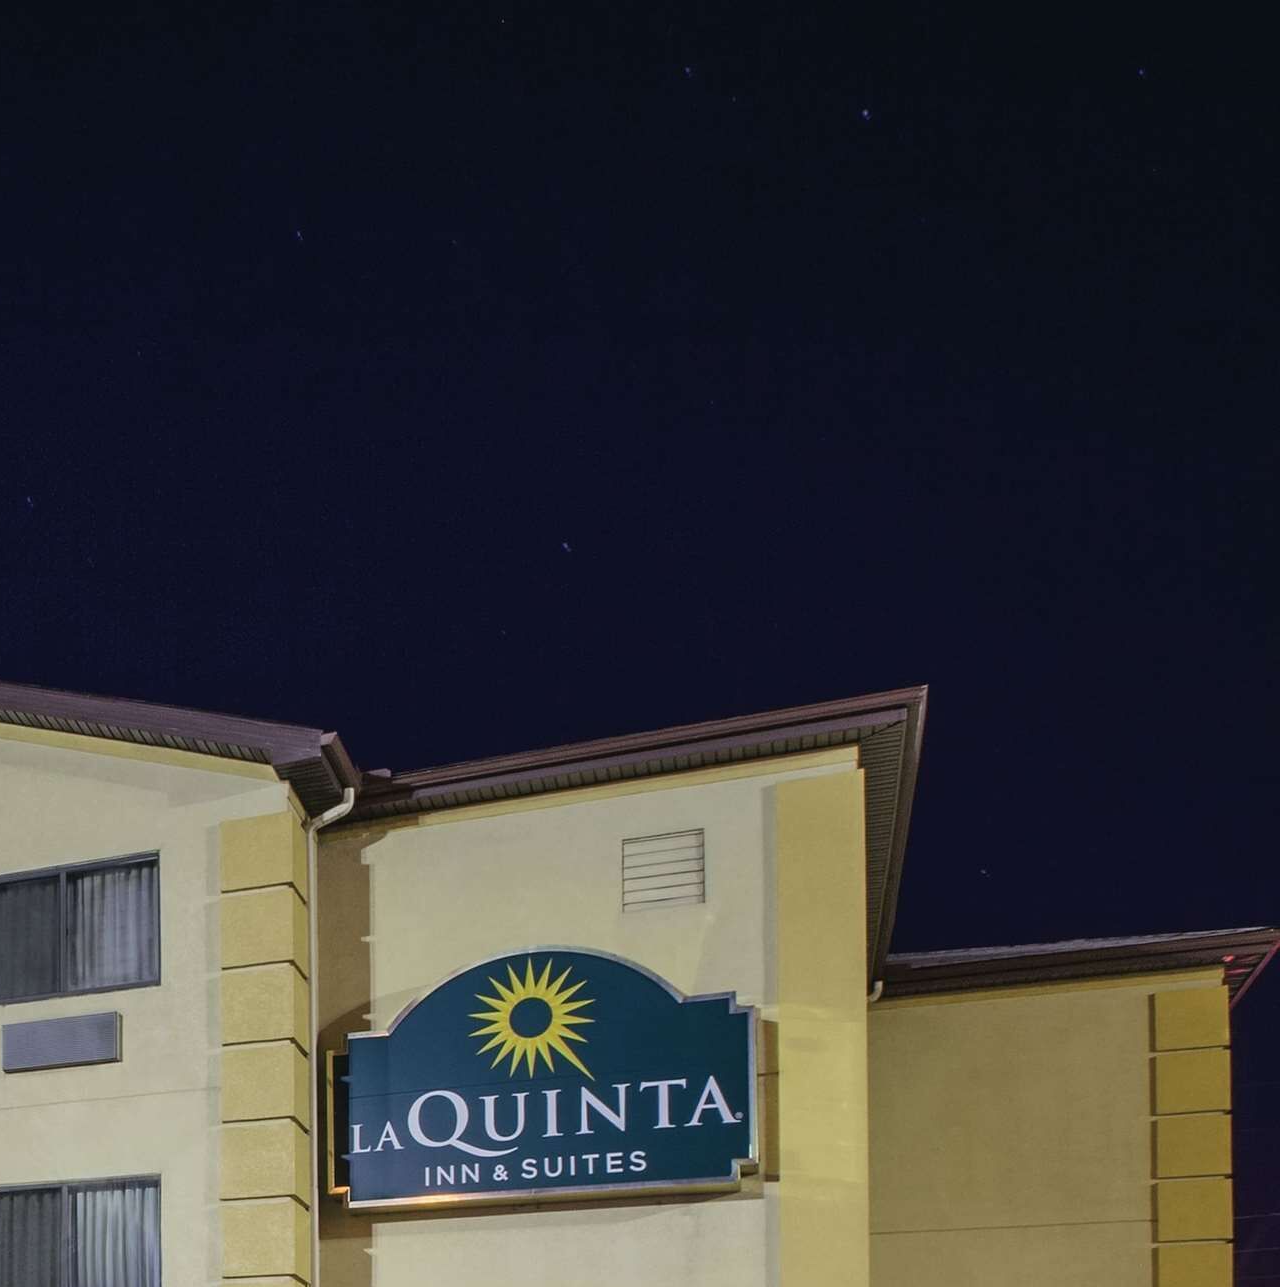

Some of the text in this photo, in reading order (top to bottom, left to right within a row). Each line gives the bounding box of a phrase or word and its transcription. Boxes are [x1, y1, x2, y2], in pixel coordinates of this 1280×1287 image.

[352, 1076, 741, 1157] LA QUINTA
[425, 1151, 647, 1186] INN & SUITES
